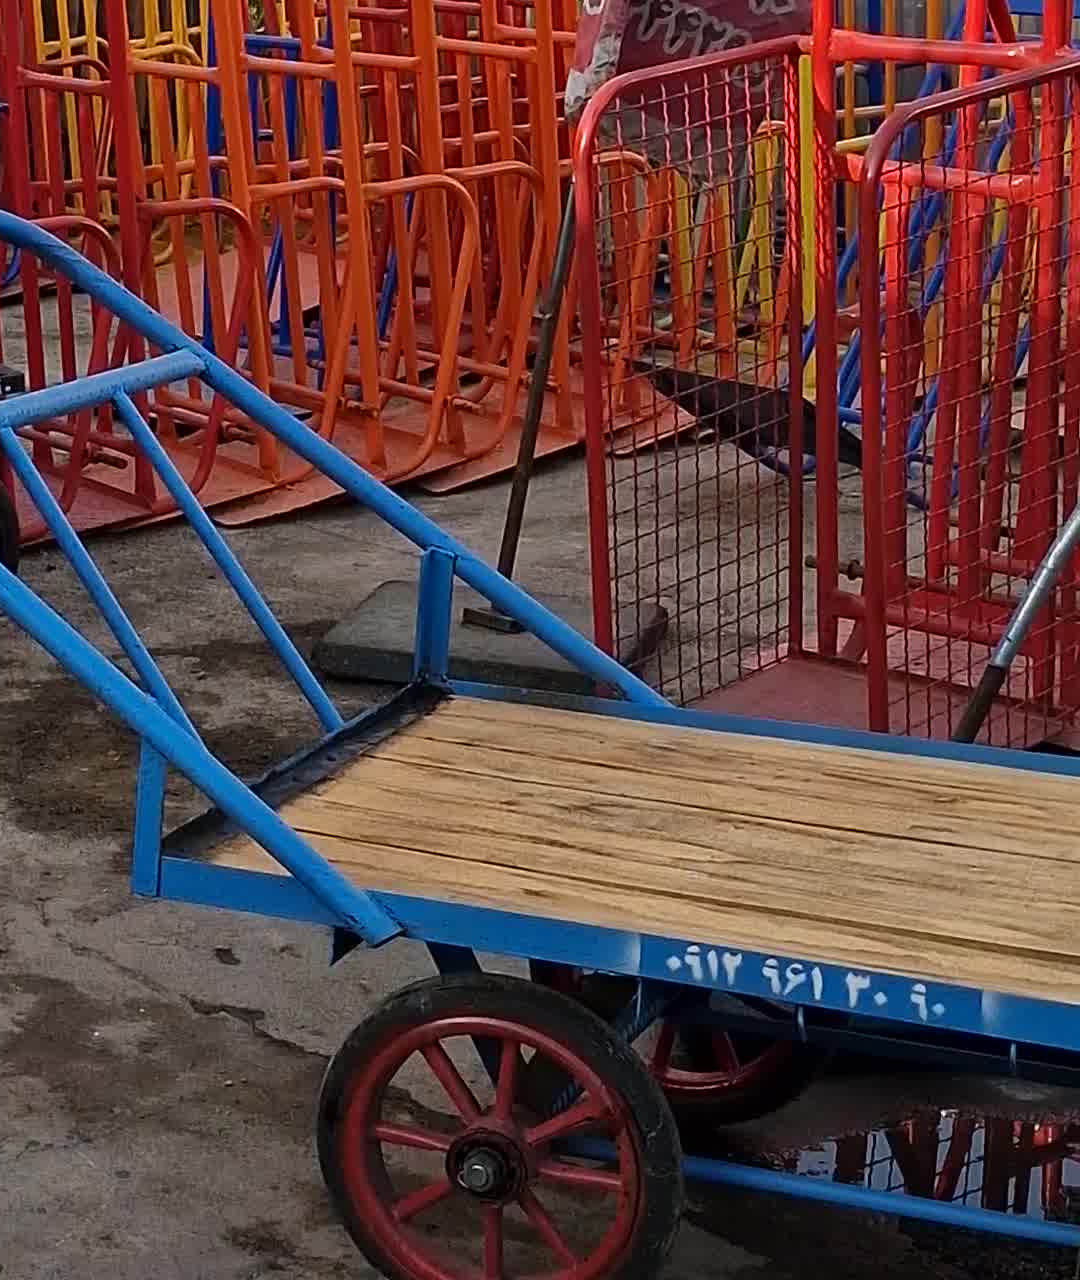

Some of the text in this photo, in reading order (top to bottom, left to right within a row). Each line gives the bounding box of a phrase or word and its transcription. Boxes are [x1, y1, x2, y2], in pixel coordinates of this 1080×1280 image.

[665, 944, 946, 1024] ۰۹۱۲ ۹۶۱ ۳۰ ۹۰
